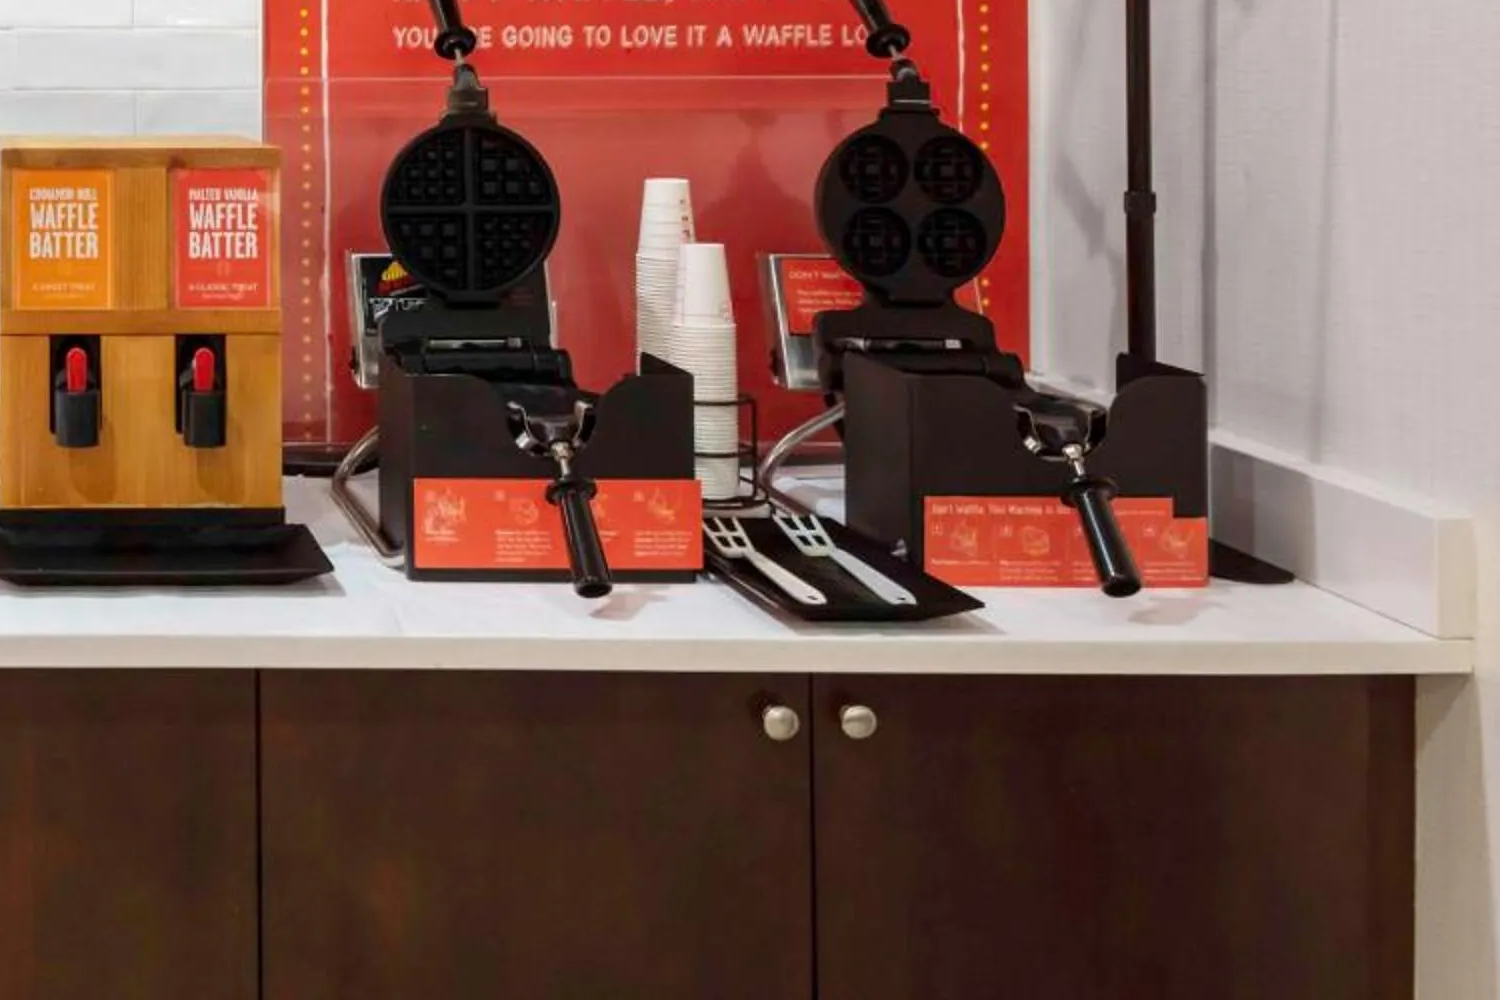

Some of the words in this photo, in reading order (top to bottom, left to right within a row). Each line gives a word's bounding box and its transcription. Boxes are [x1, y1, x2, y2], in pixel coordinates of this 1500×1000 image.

[393, 26, 492, 49] YOUE
[502, 25, 573, 48] GOING
[584, 25, 611, 47] TO
[621, 25, 678, 47] LOVE
[687, 25, 707, 46] IT
[716, 25, 732, 46] A
[743, 24, 833, 47] WAFFLE
[841, 23, 870, 47] LO
[29, 202, 99, 230] WAFFLE
[189, 202, 259, 230] WAFFLE
[29, 231, 99, 260] BATTER
[188, 231, 258, 260] BATTER
